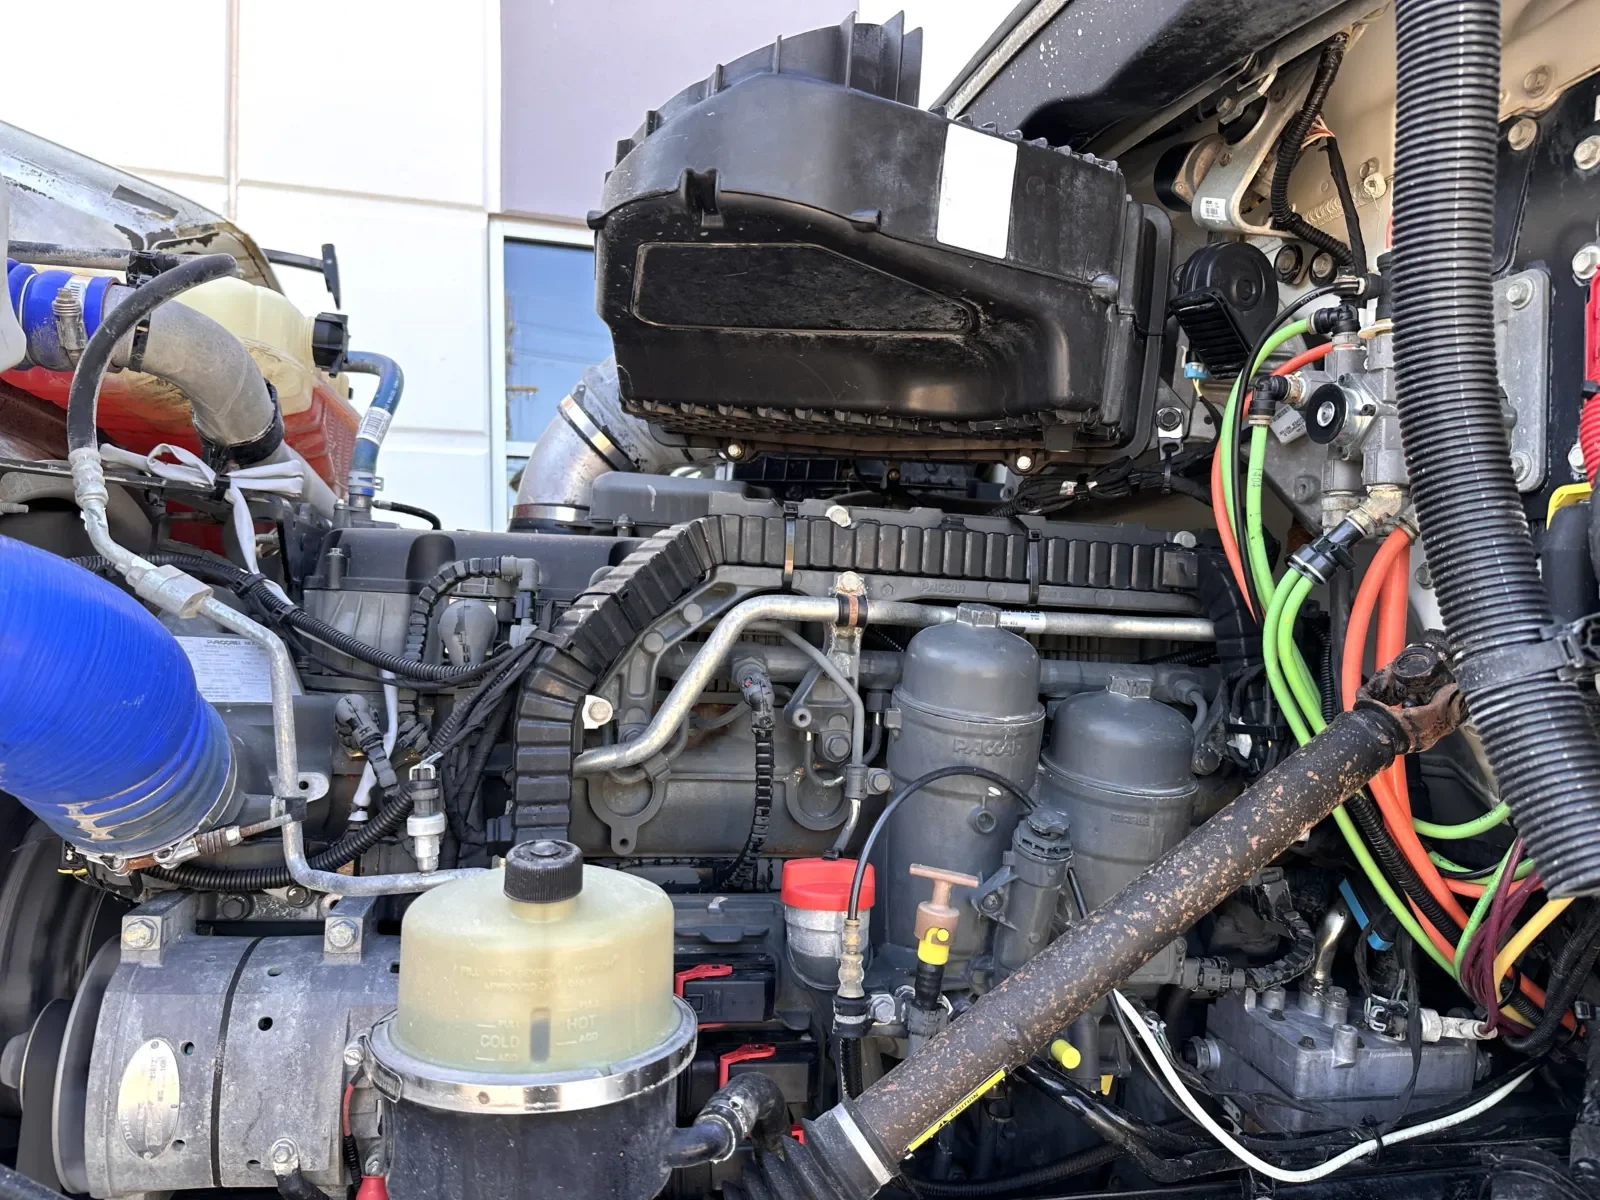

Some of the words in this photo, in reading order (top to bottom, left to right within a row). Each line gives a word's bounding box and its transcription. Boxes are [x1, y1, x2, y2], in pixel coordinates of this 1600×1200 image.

[952, 738, 1023, 757] PACCAR
[566, 1014, 597, 1031] HOT
[479, 1034, 520, 1048] COLD
[950, 1092, 979, 1117] CAUTION
